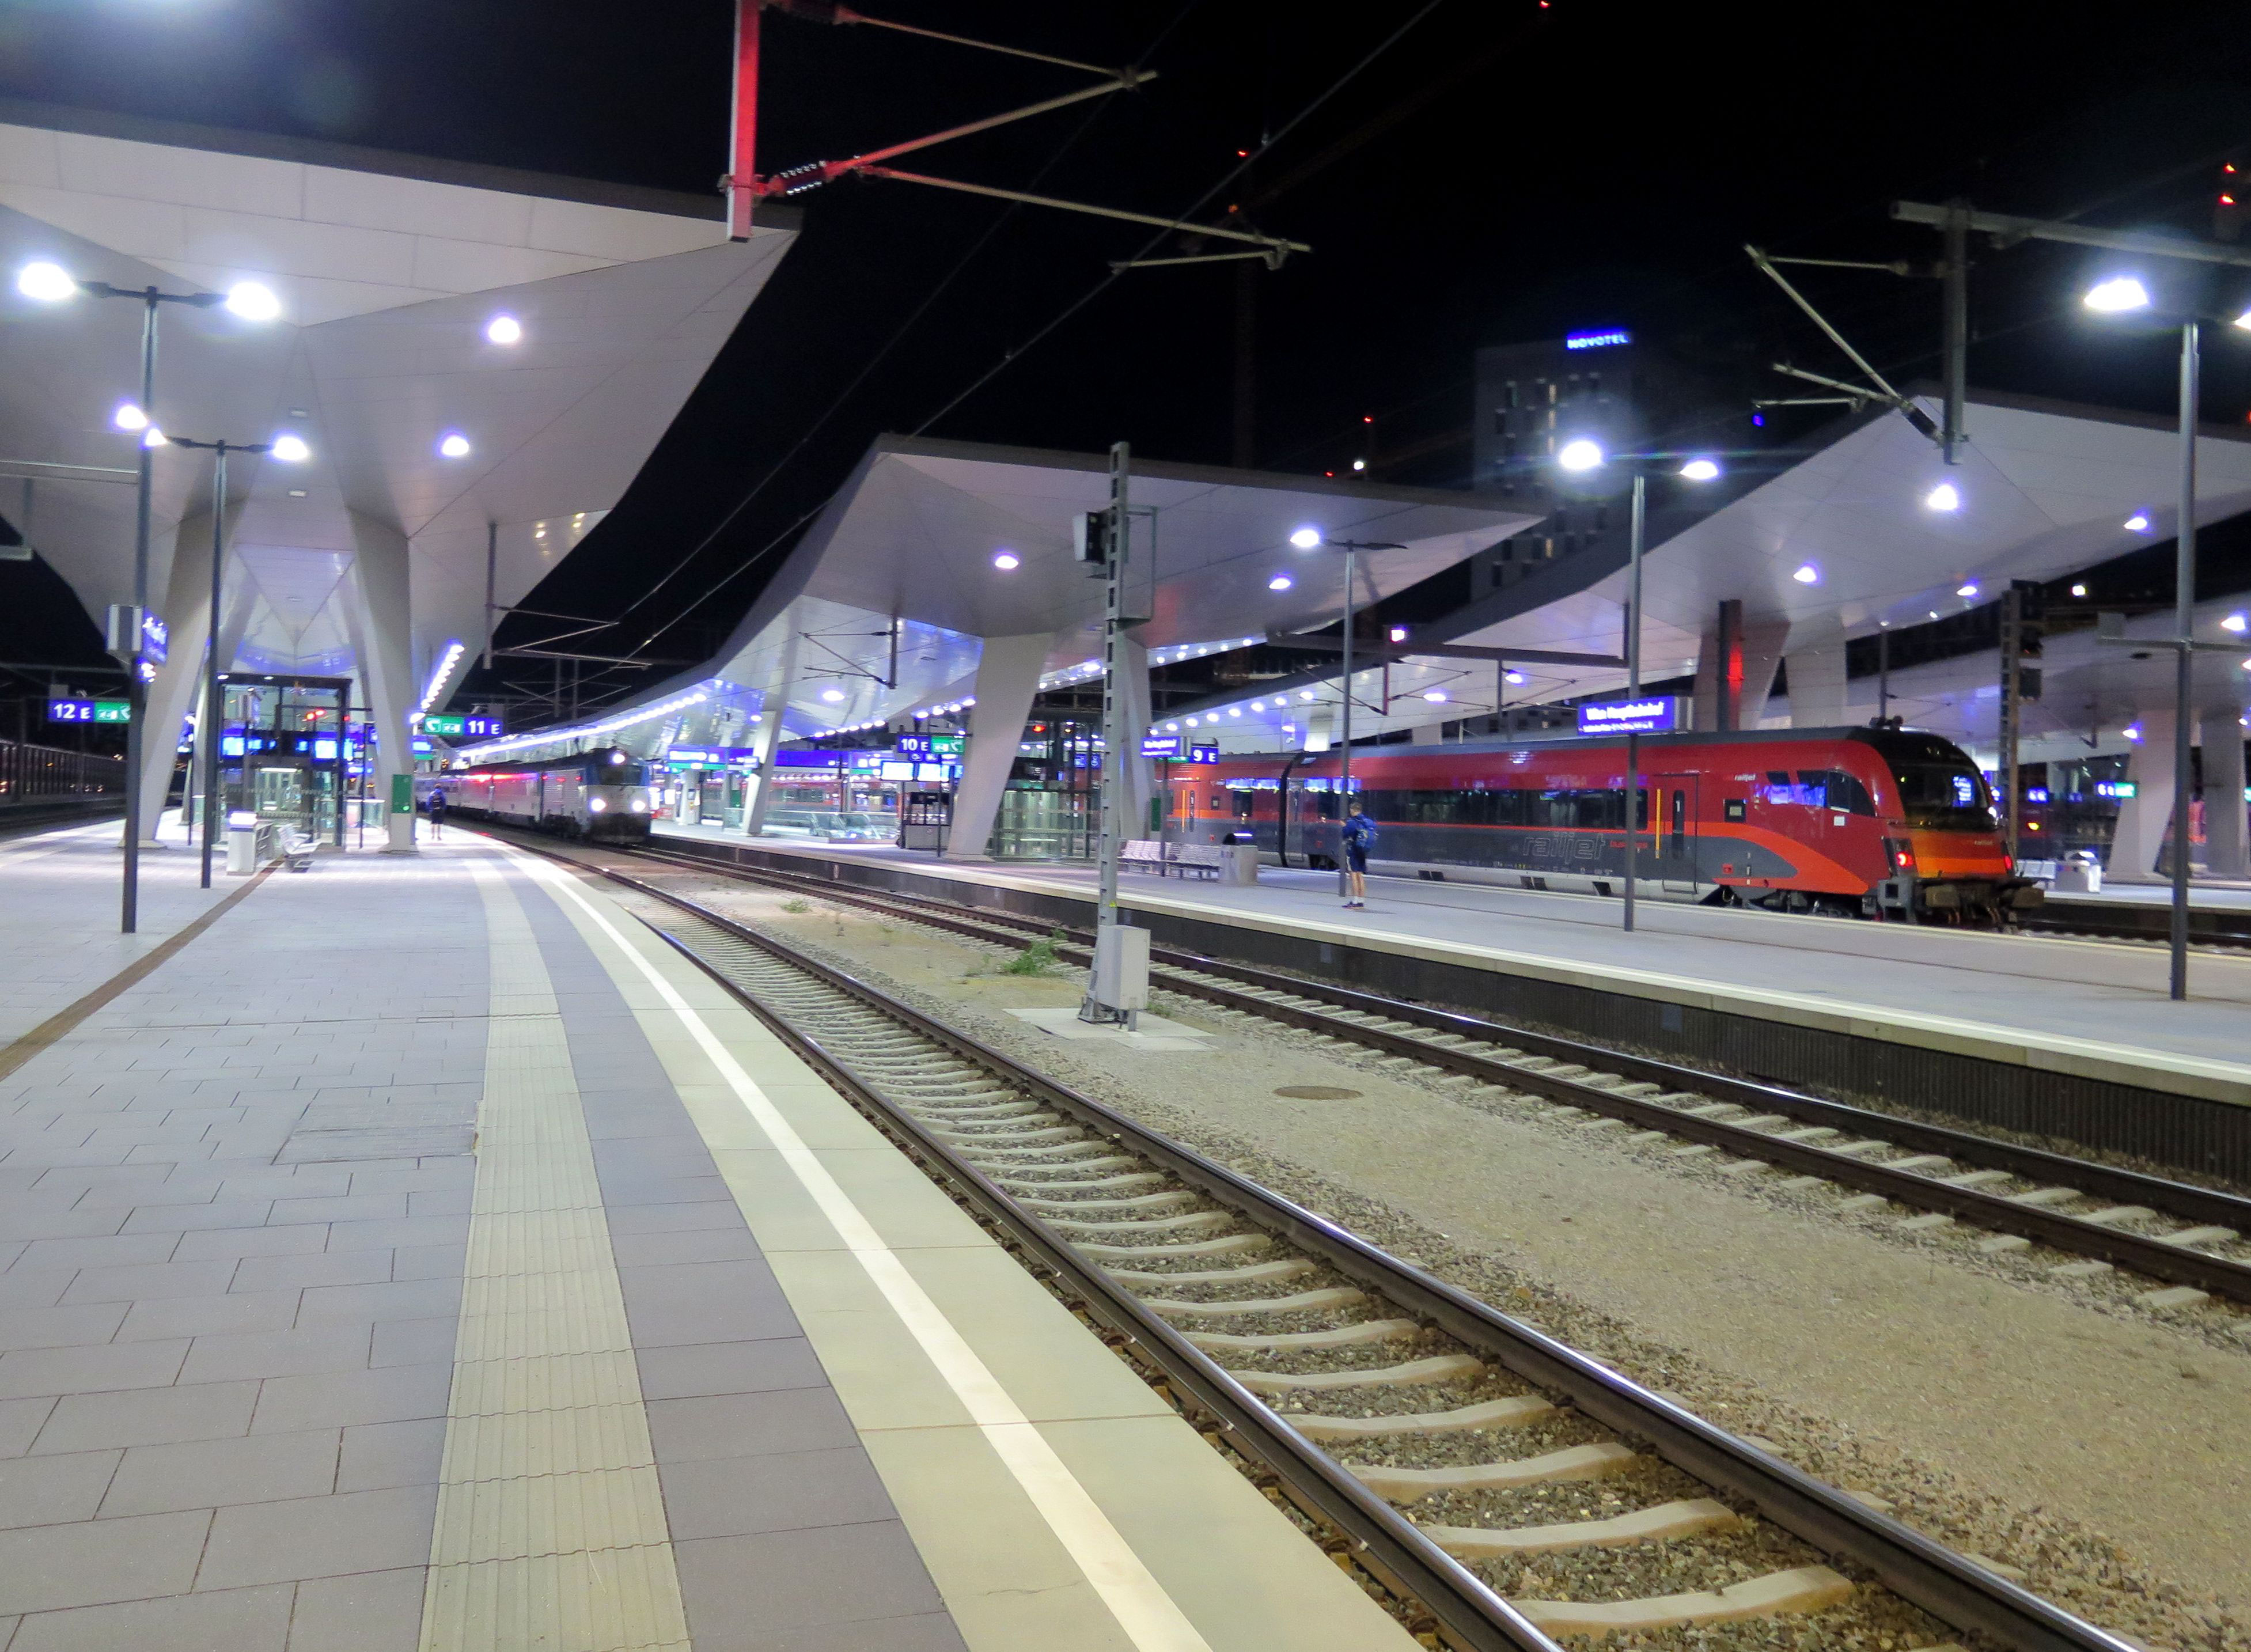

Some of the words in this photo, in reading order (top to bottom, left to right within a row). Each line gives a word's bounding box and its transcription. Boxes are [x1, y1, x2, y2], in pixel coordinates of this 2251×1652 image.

[1567, 334, 1628, 349] NOVOTEL
[54, 703, 75, 719] 12
[80, 707, 90, 719] E
[468, 720, 485, 734] 11
[491, 723, 500, 734] E
[901, 738, 918, 751] 10
[920, 741, 929, 751] E
[1192, 749, 1203, 762] 9
[1208, 752, 1216, 762] E
[1676, 800, 1681, 812] 1
[1522, 832, 1606, 865] railjet
